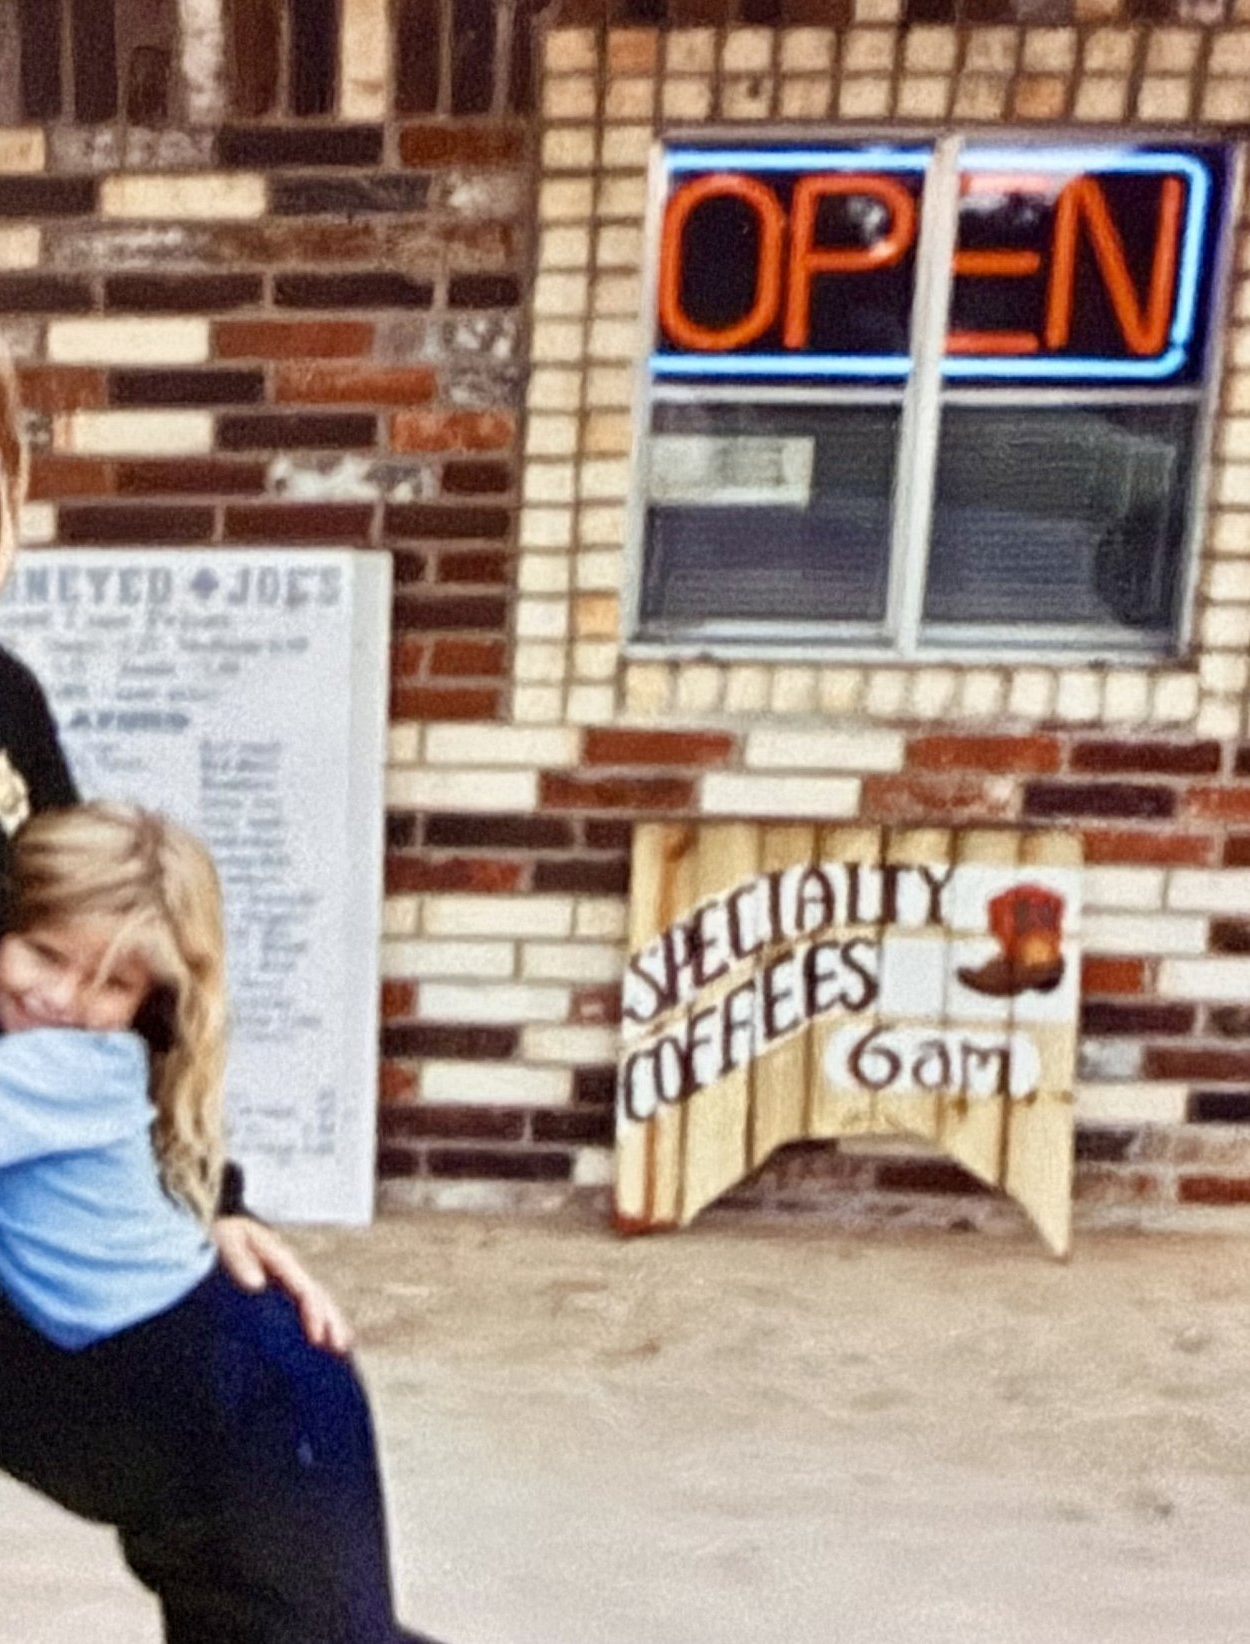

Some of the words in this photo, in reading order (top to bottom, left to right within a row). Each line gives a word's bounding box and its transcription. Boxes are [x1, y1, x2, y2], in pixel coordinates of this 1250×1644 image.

[657, 173, 1185, 355] OPEN
[2, 566, 173, 606] NEYED
[623, 861, 954, 1024] SPECIALTY
[624, 936, 880, 1123] COFFEES
